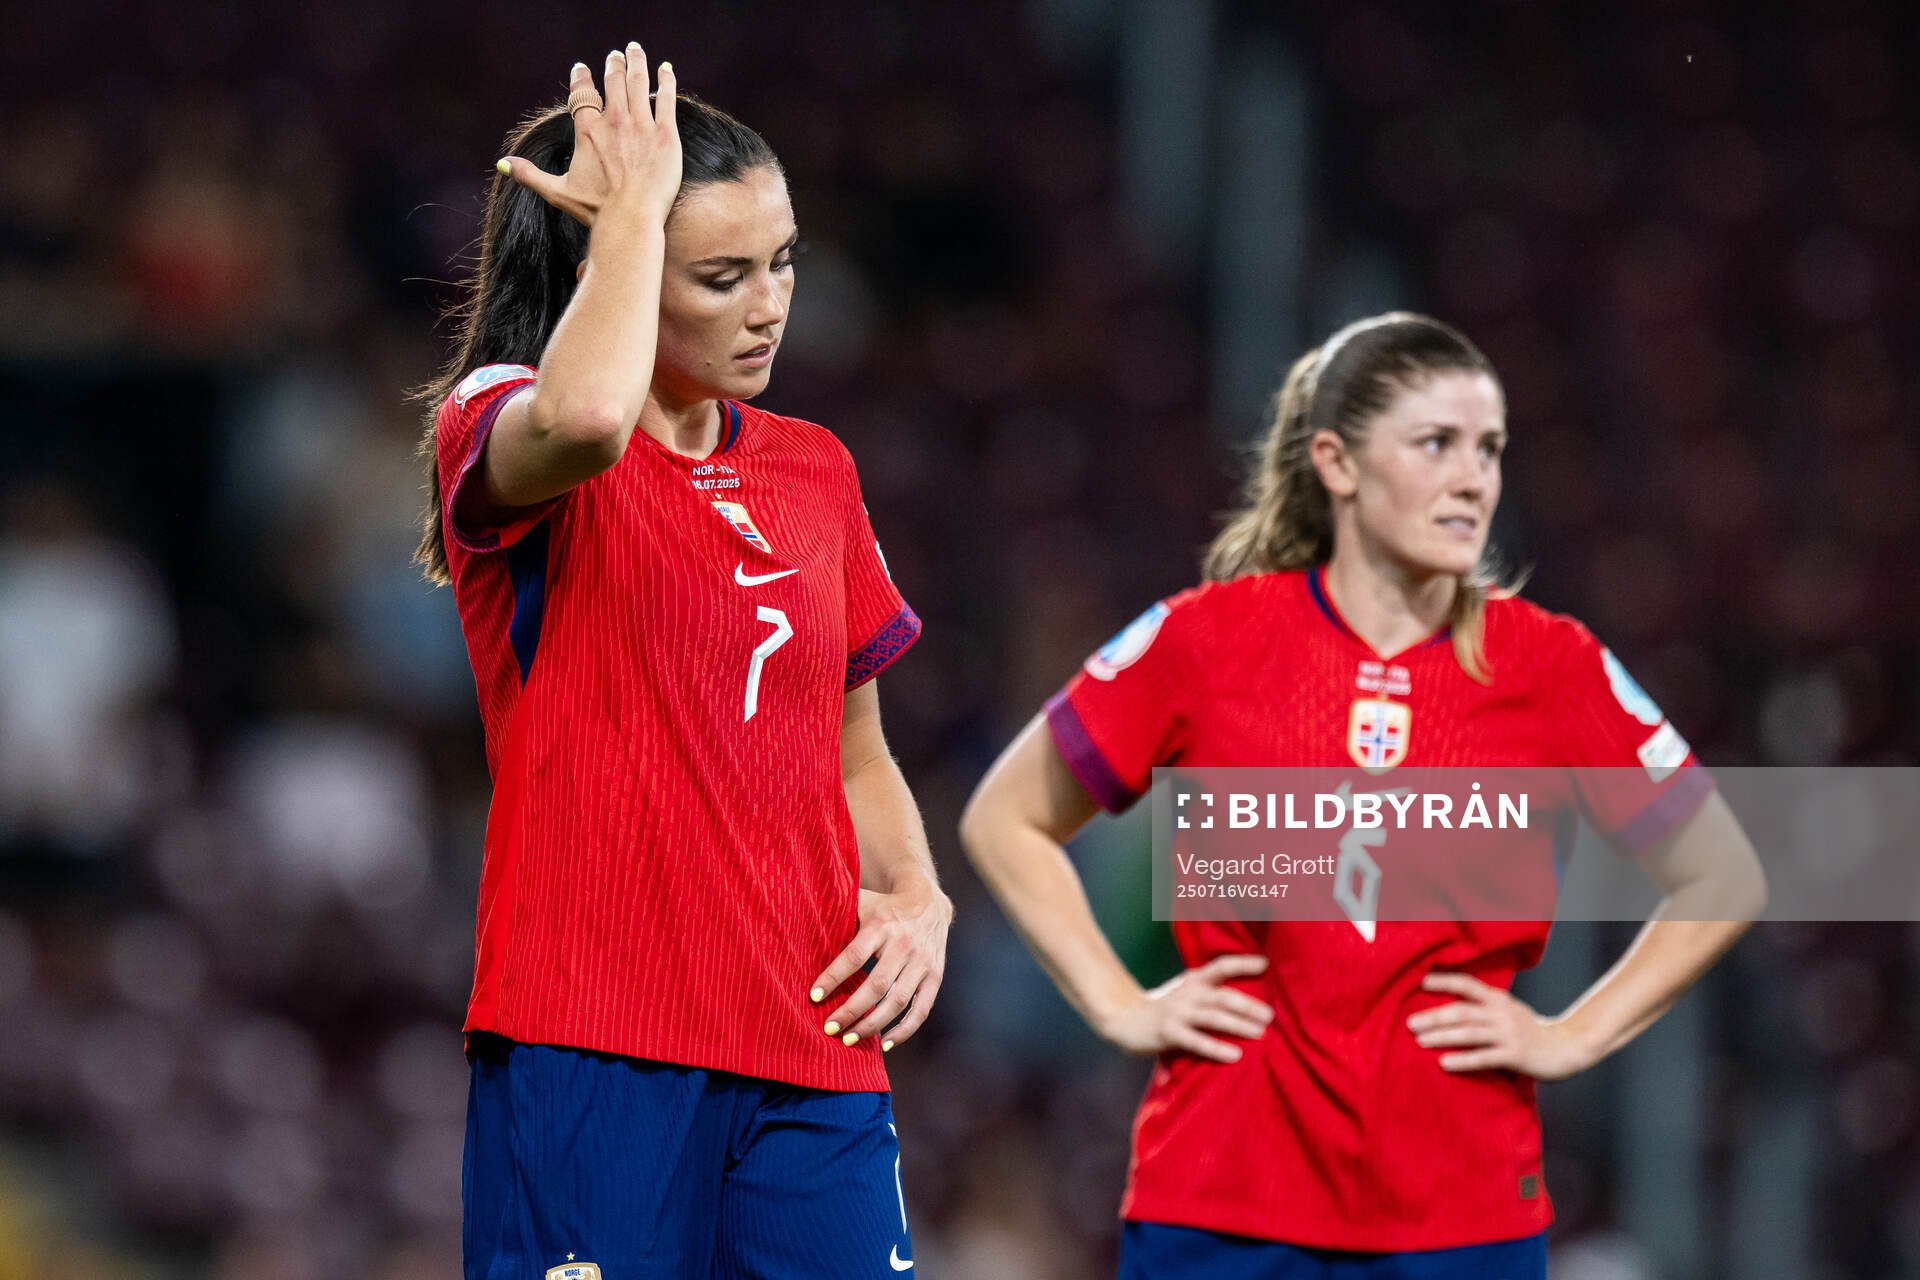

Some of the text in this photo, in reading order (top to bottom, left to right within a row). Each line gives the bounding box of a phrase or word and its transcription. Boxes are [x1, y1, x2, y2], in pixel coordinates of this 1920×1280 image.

[692, 464, 714, 476] NOR
[744, 605, 794, 723] 7
[1332, 826, 1388, 944] 6
